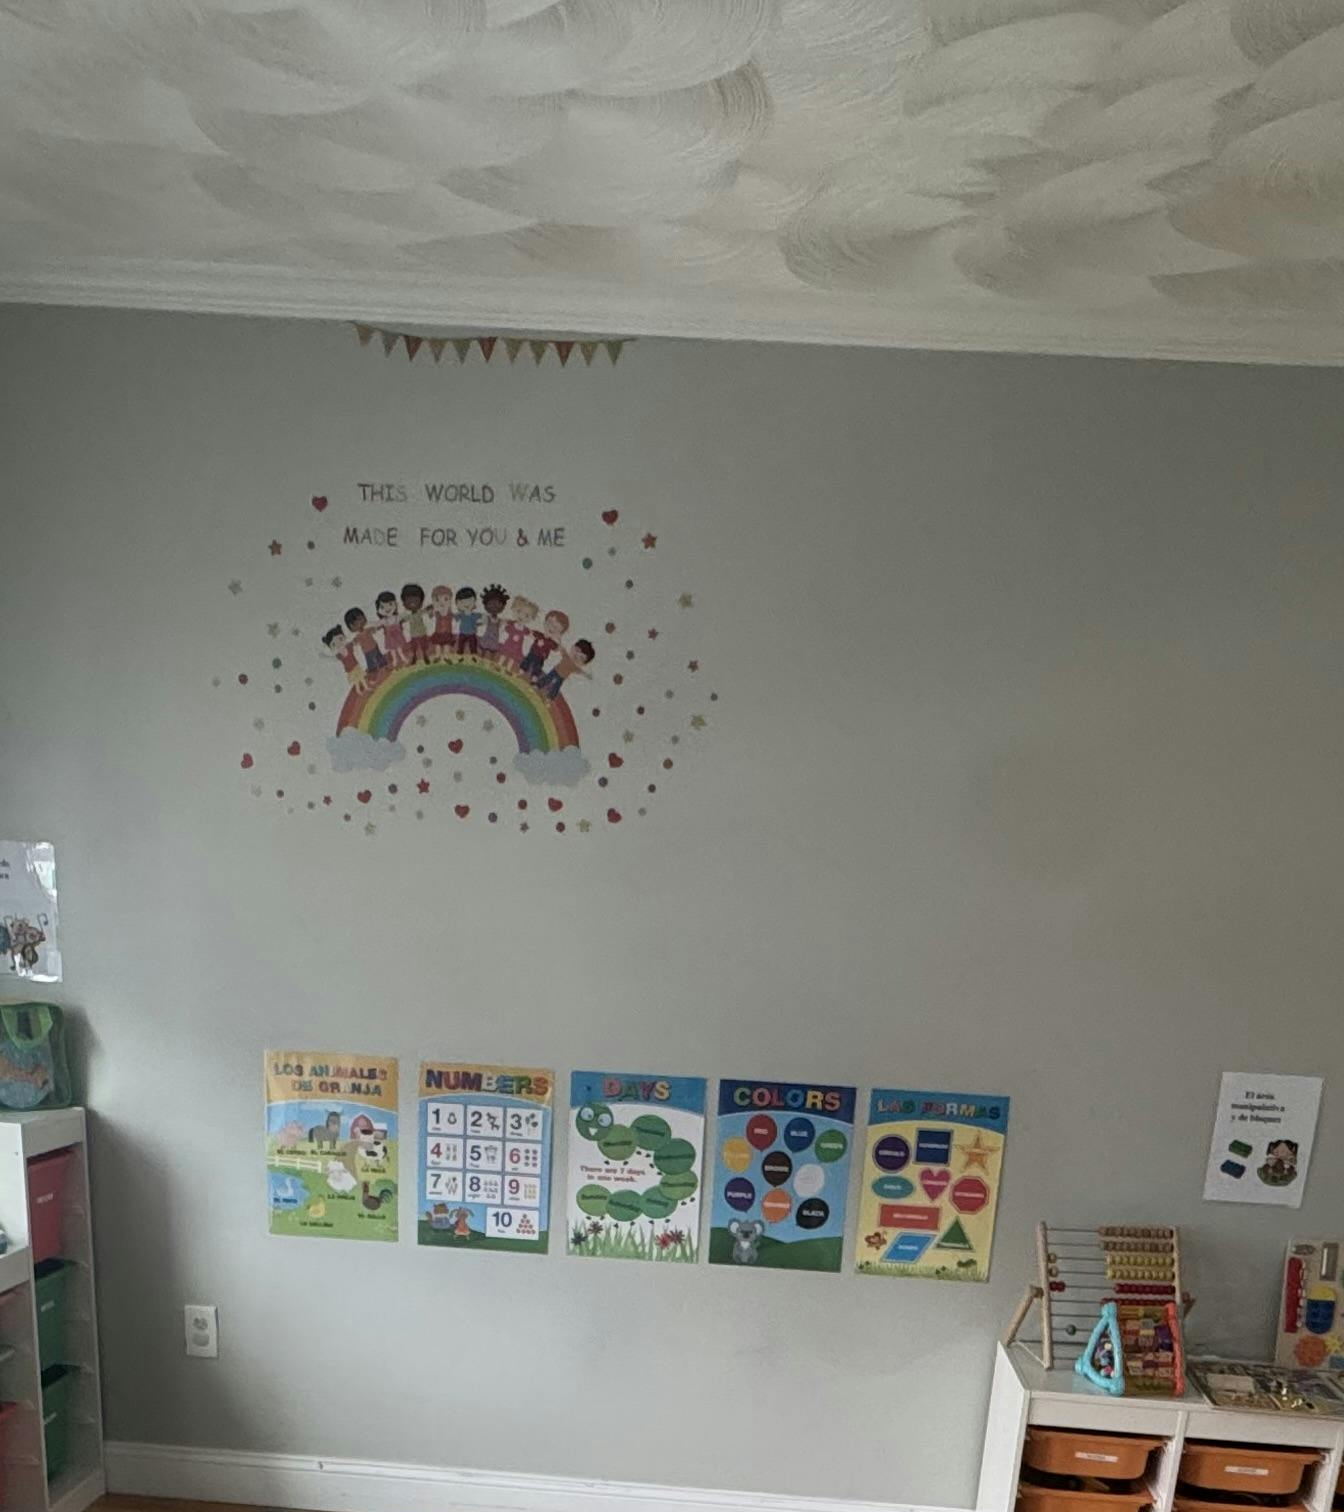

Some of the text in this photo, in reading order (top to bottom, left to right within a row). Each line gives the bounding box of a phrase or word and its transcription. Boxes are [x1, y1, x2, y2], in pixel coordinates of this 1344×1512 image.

[358, 483, 556, 503] THIS WORLD WAS
[343, 526, 566, 548] MADE FOR YOU & ME
[425, 1068, 551, 1097] NUMBERS
[602, 1078, 673, 1102] DAYS
[733, 1086, 842, 1112] COLORS
[431, 1108, 441, 1125] 1
[470, 1110, 483, 1128] 2
[509, 1113, 523, 1130] 3
[430, 1142, 443, 1159] 4
[469, 1145, 482, 1162] 5
[509, 1147, 521, 1165] 6
[430, 1173, 442, 1189] 7
[468, 1175, 481, 1193] 8
[508, 1178, 521, 1195] 9
[492, 1211, 513, 1228] 10
